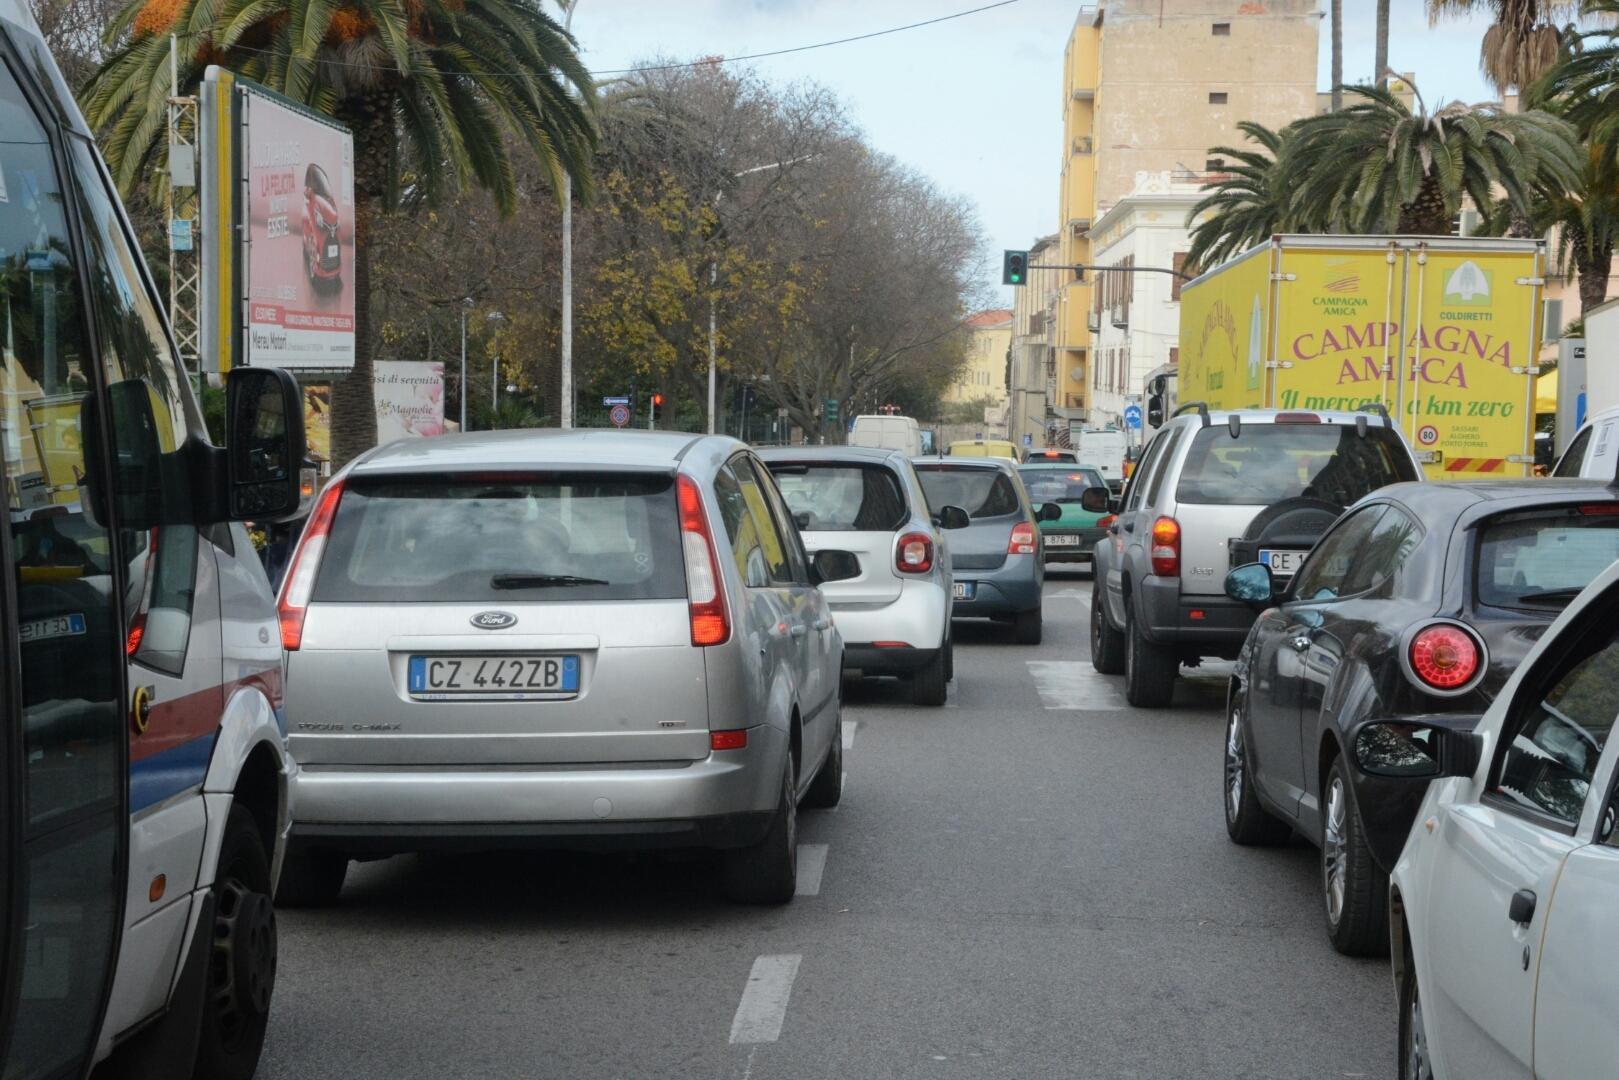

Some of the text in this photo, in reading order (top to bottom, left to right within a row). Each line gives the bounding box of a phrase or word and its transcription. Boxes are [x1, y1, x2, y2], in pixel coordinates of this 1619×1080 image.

[1312, 297, 1368, 306] CAMPAGNA
[1323, 307, 1356, 316] AMICA
[1440, 312, 1493, 321] COLDIRETTI
[1336, 355, 1468, 388] AMICA
[388, 374, 398, 384] di
[400, 375, 440, 385] serenità
[390, 404, 433, 416] Magnolie
[1426, 394, 1462, 416] km
[1467, 400, 1514, 418] zero
[1423, 431, 1434, 440] 80
[1272, 553, 1291, 570] CE
[1190, 567, 1214, 576] Jeep
[480, 614, 506, 624] Ford
[429, 660, 559, 688] CZ 442ZB
[298, 722, 400, 730] FOCUS C-MAX
